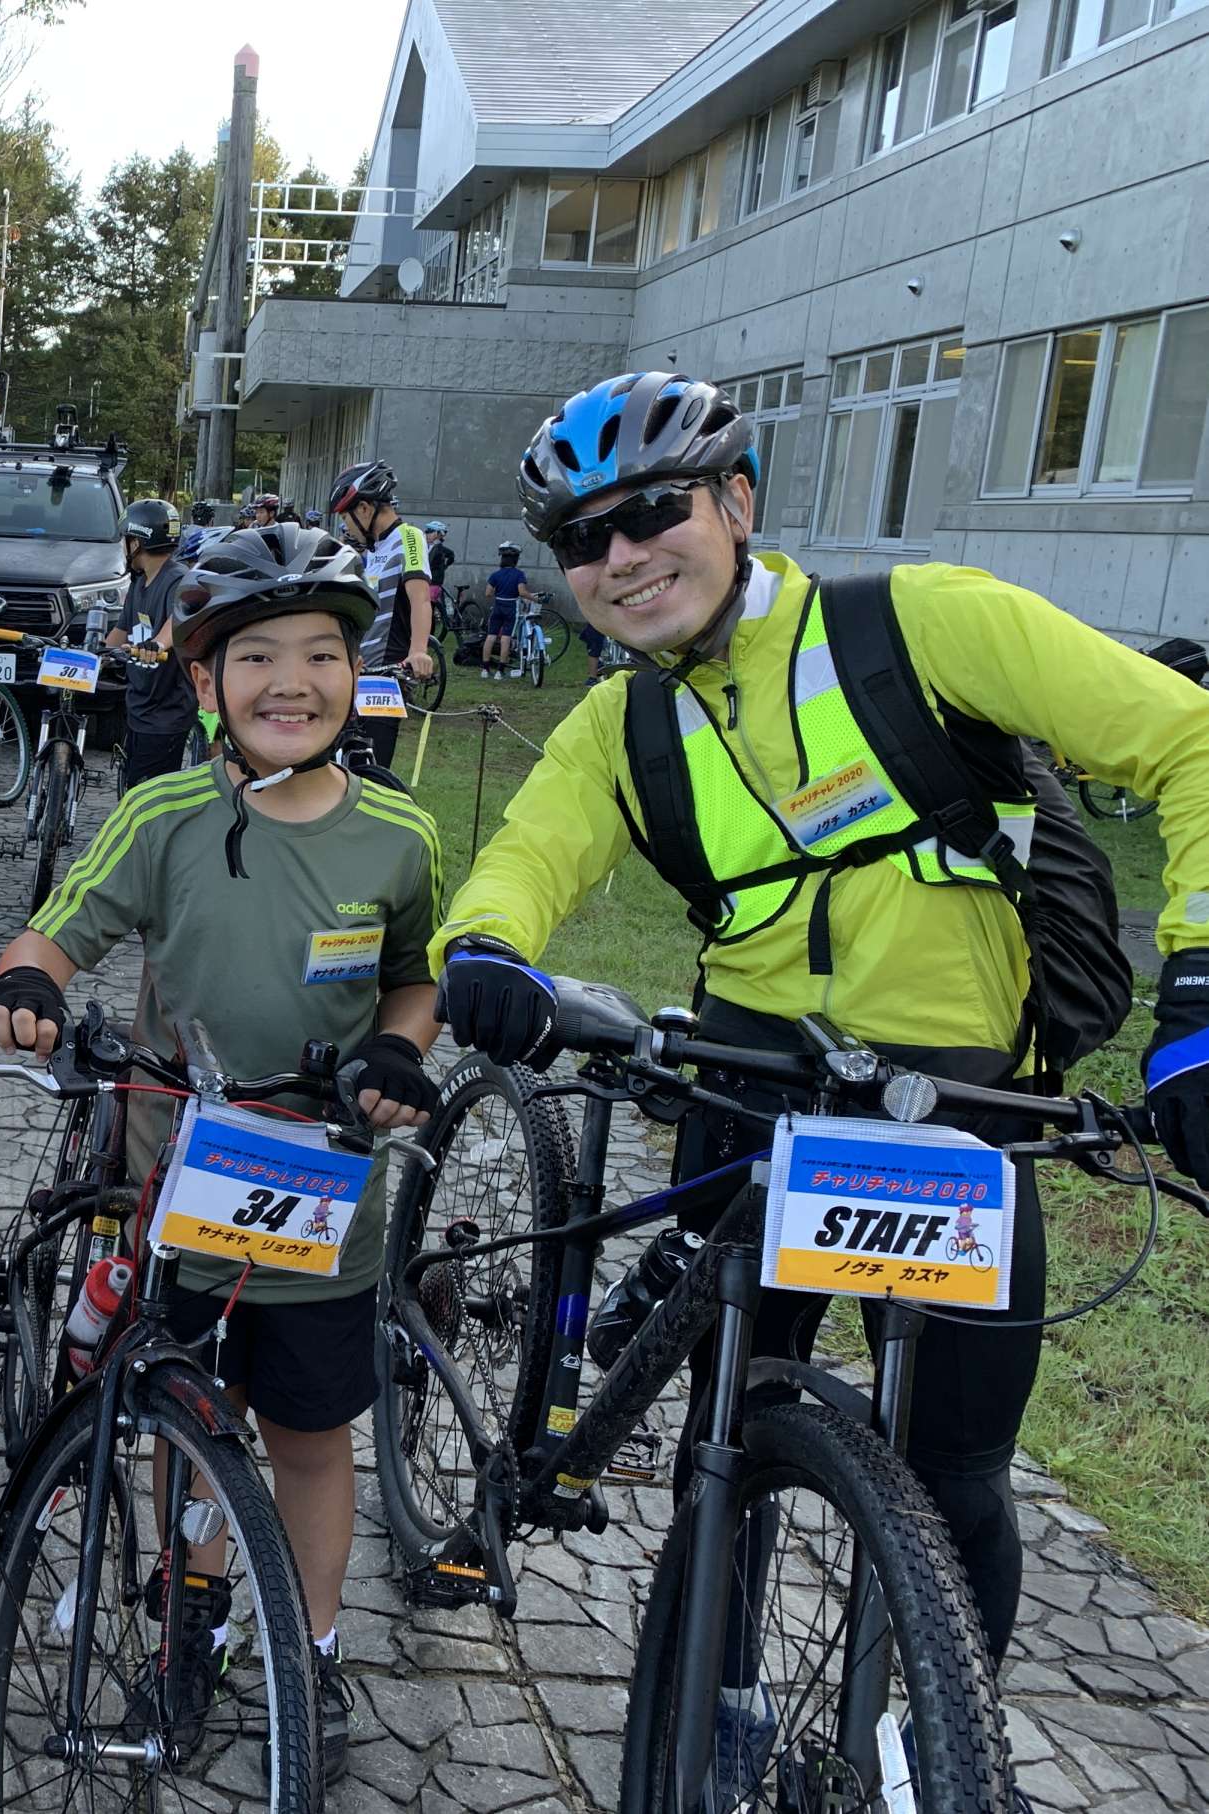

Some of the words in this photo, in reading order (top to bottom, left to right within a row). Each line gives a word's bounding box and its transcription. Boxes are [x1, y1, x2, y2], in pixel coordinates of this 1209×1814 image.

[60, 666, 78, 679] 30
[365, 695, 391, 706] STAFF
[837, 766, 864, 787] 2020
[847, 794, 879, 818] カズヤ
[336, 901, 379, 915] adidas
[440, 1065, 482, 1107] MAXXIS
[205, 1151, 350, 1195] チャリチャレ2020
[811, 1170, 988, 1201] チャリチャレ2020
[232, 1188, 302, 1233] 34
[197, 1224, 250, 1245] ヤナギヤ
[261, 1238, 313, 1258] リョウガ
[814, 1205, 951, 1257] STAFF
[833, 1260, 885, 1277] ノグチ
[898, 1265, 950, 1284] カズヤ
